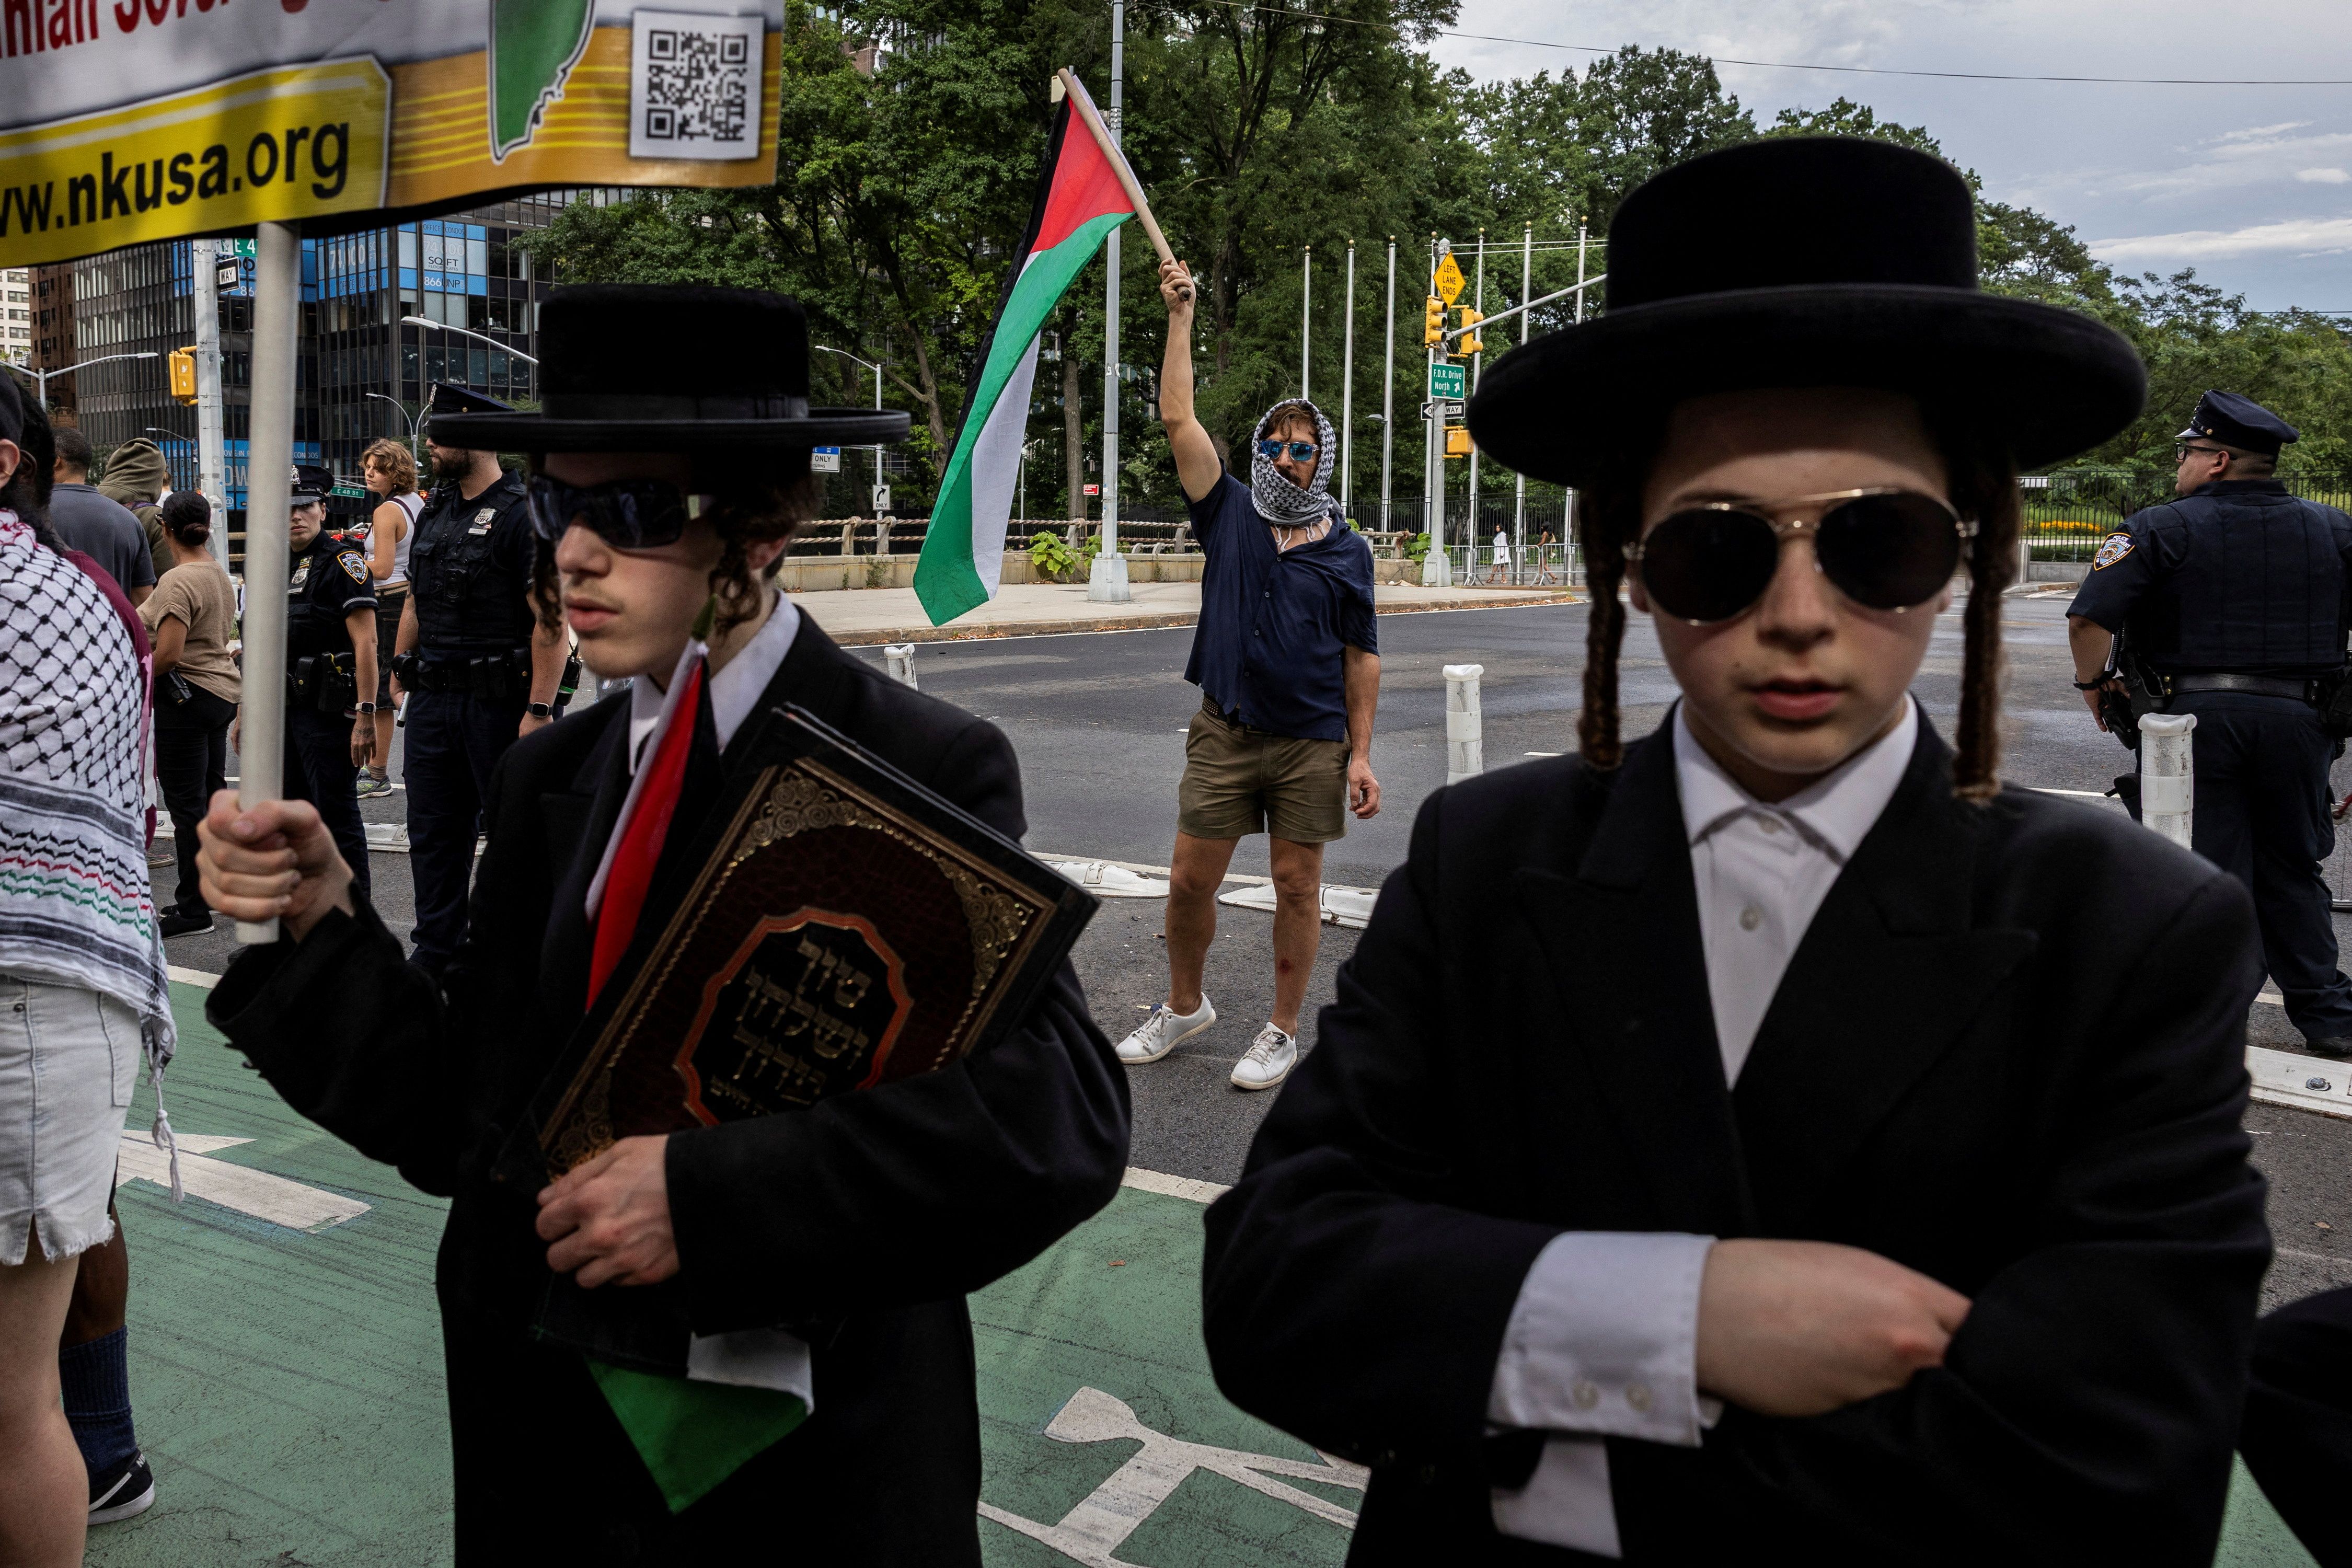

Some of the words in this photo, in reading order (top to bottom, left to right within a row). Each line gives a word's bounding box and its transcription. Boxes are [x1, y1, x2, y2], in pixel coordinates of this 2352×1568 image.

[0, 0, 99, 59] nian
[445, 226, 465, 235] CONDOS
[247, 238, 257, 254] 4
[428, 256, 444, 266] SQ
[446, 258, 459, 267] FT
[1443, 264, 1456, 274] LEFT
[220, 269, 233, 283] WAY
[1443, 275, 1457, 285] LANE
[340, 278, 355, 292] OFFCE
[240, 286, 257, 297] 86
[1443, 286, 1456, 296] ENDS
[1433, 368, 1447, 378] F.D.R.
[1448, 370, 1462, 380] Drive
[1435, 381, 1450, 391] North
[2113, 550, 2128, 560] YORK
